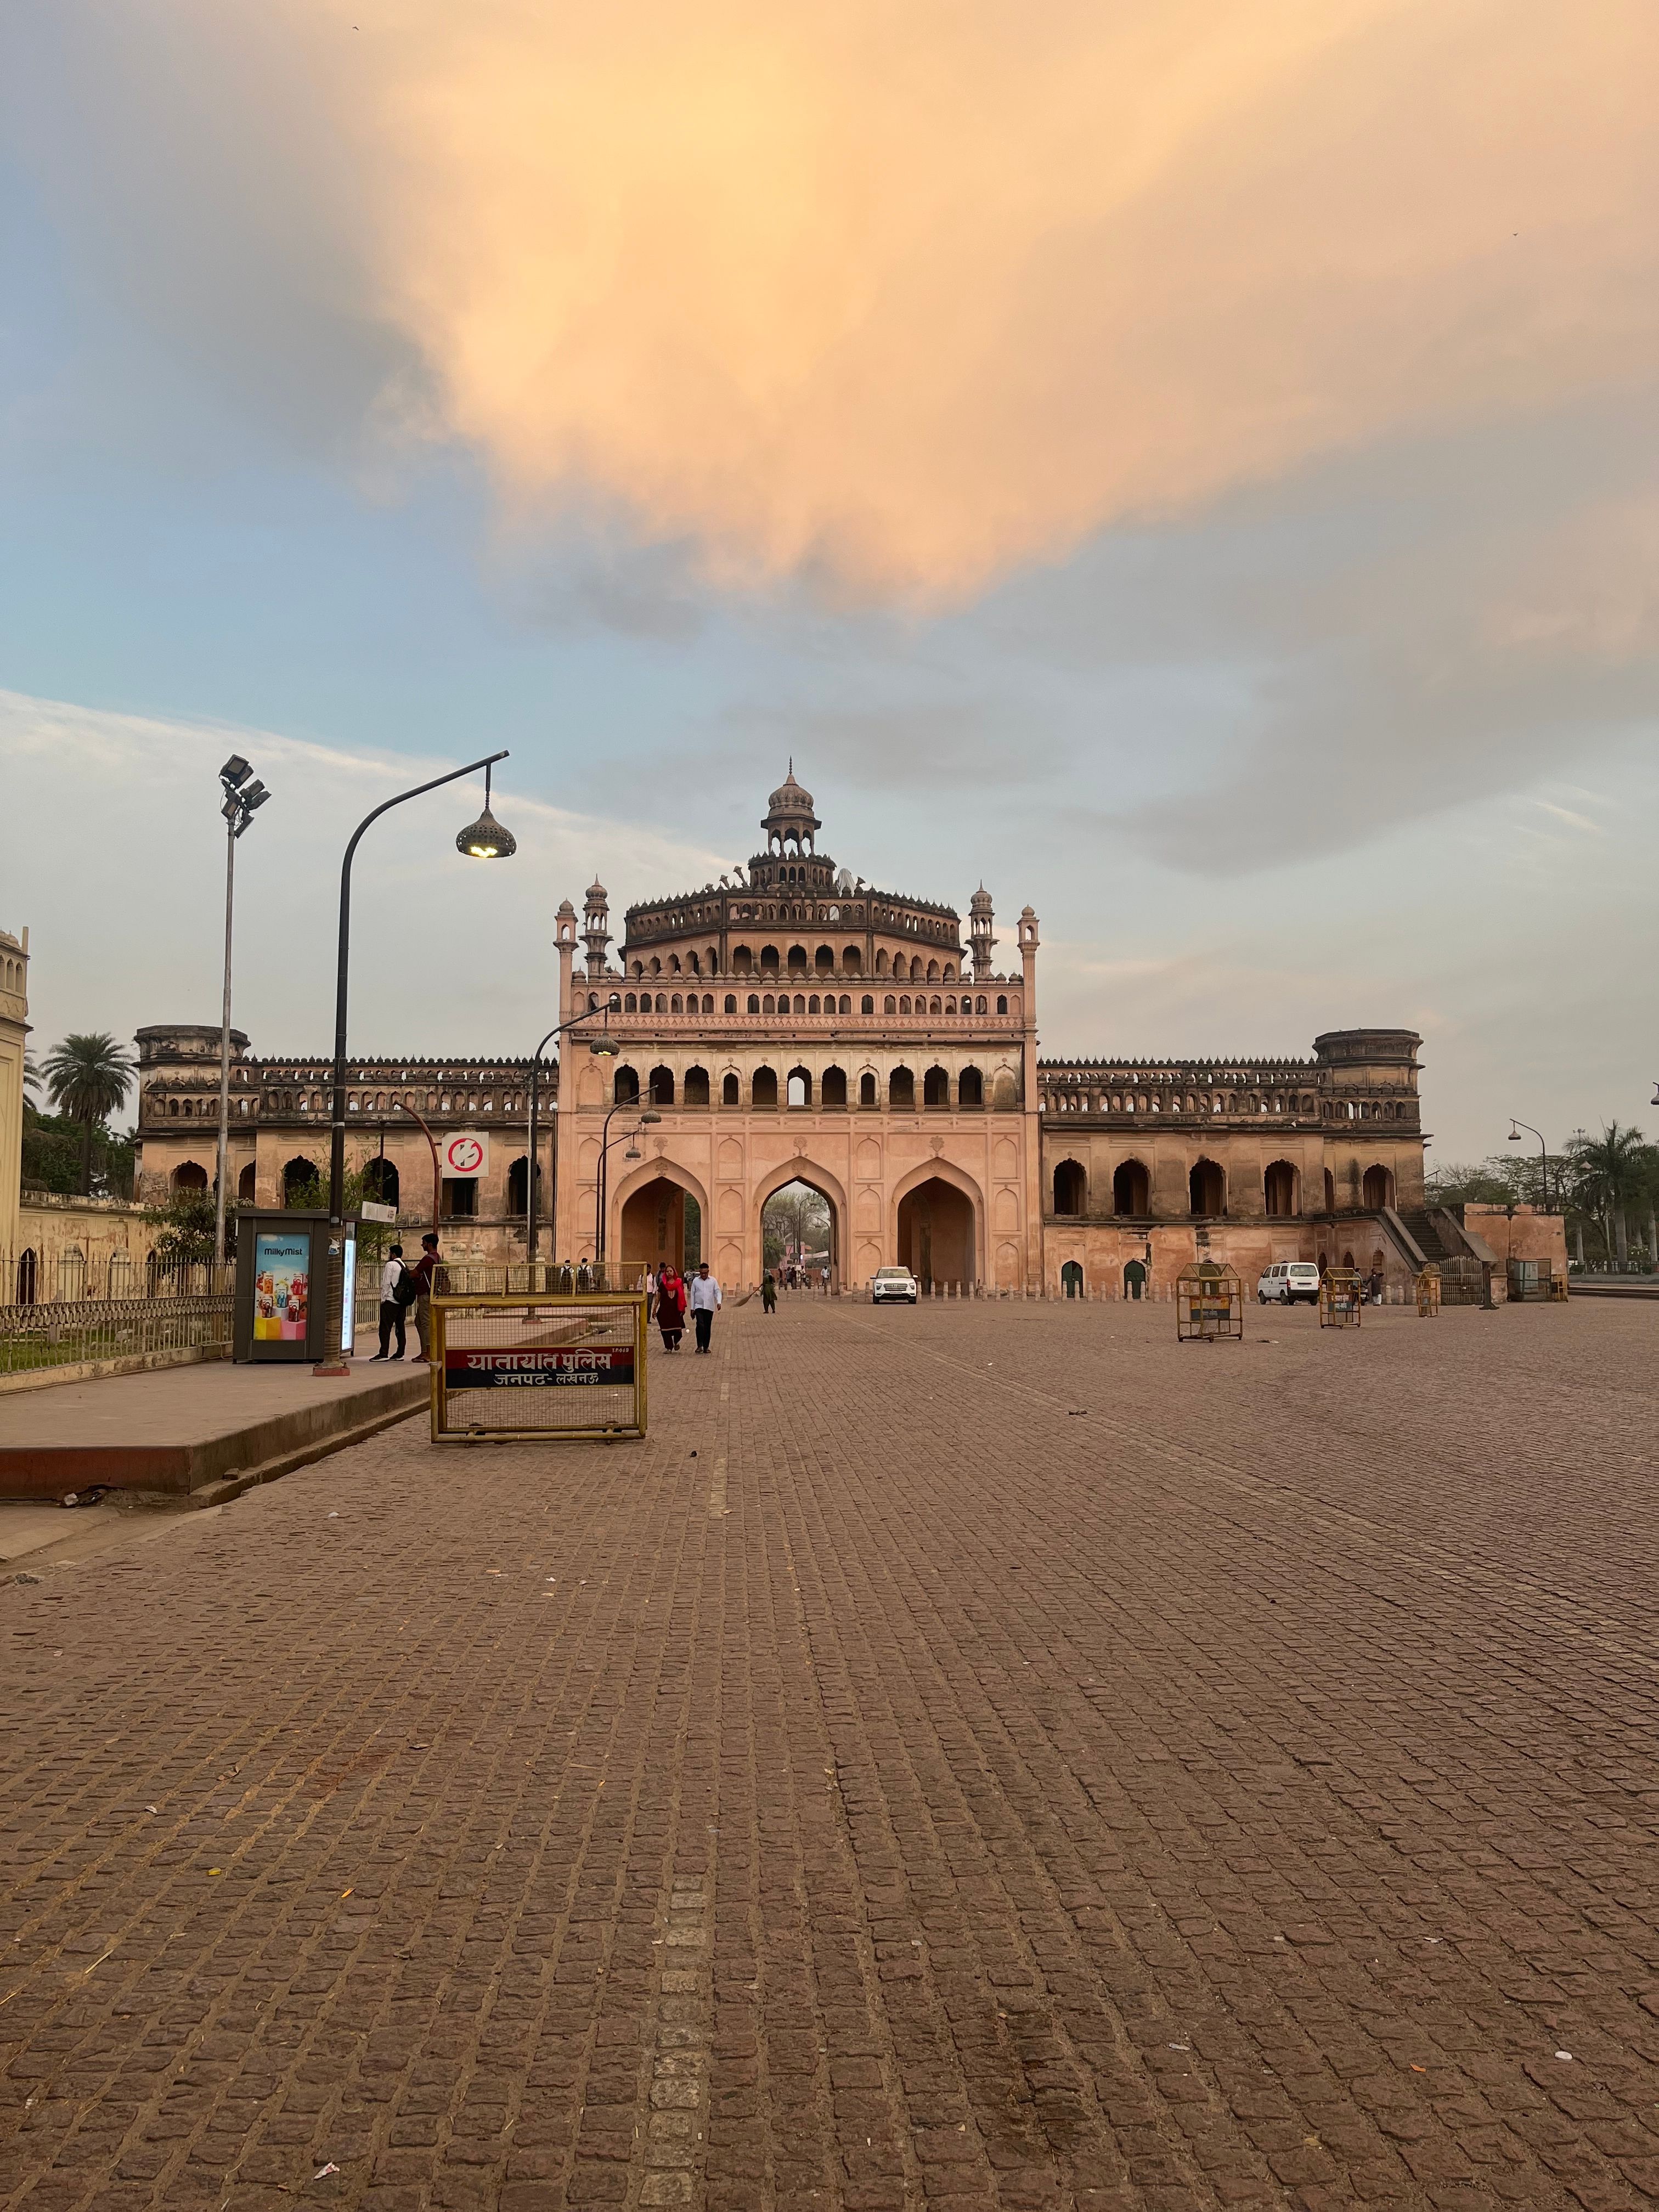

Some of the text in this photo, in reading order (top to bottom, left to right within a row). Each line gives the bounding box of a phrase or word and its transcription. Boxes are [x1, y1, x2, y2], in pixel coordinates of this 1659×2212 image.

[467, 1348, 612, 1373] यातायात पुलिस
[556, 1373, 599, 1385] लखनऊ
